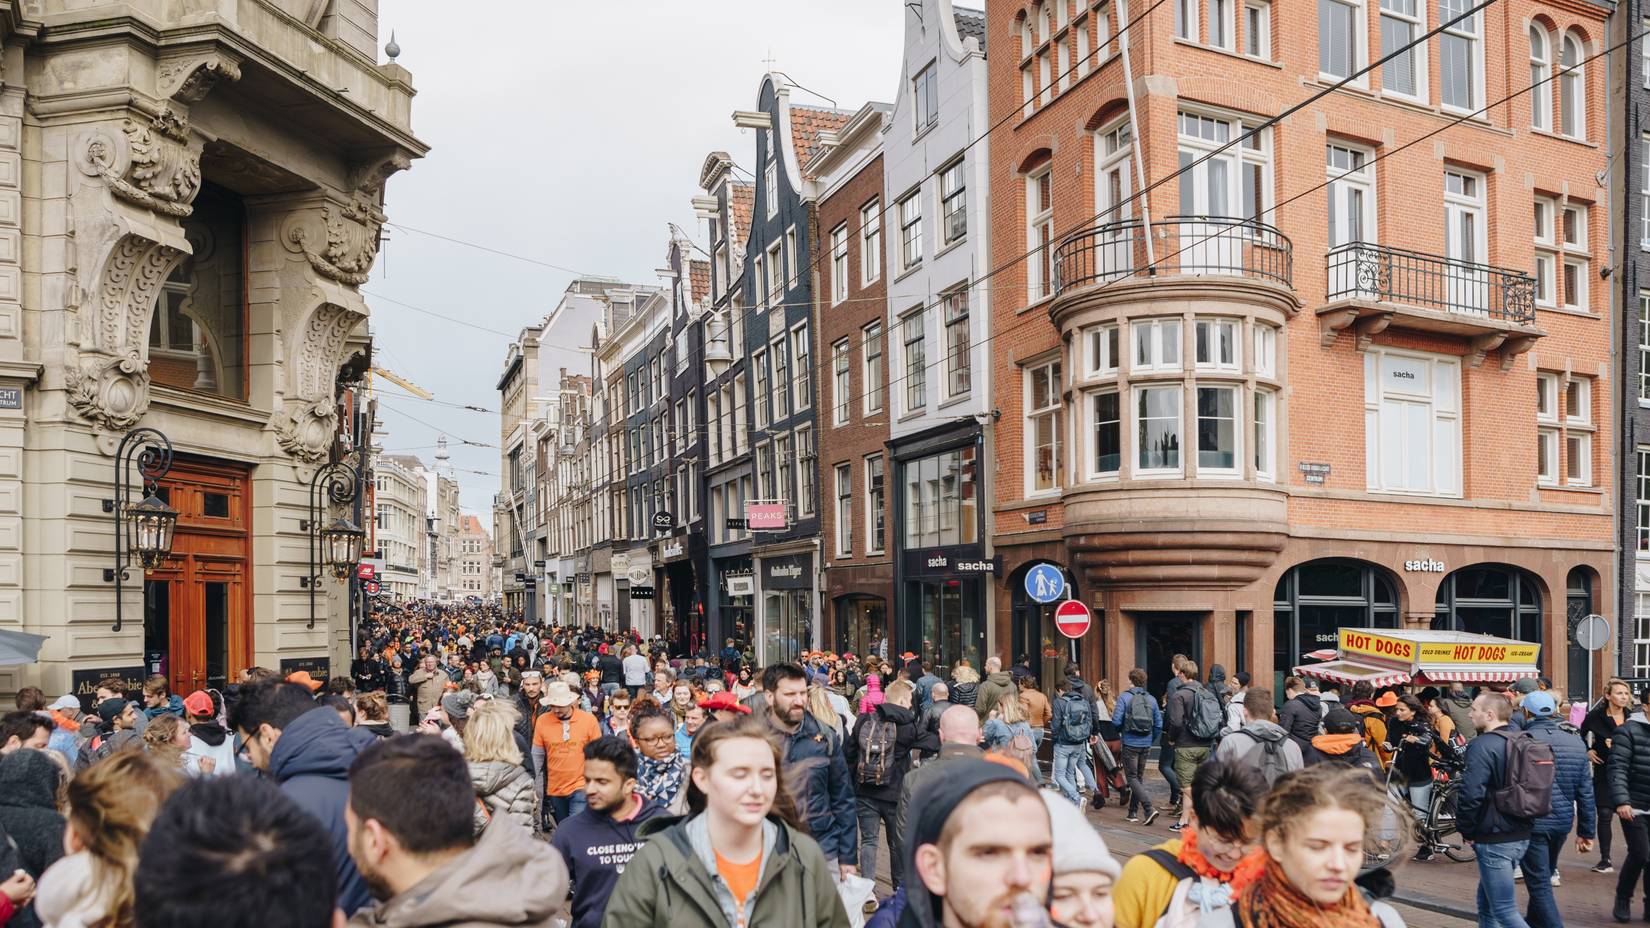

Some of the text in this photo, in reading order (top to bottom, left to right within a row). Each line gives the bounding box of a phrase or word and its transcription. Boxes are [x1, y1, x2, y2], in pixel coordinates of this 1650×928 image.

[1393, 371, 1415, 380] sacha
[927, 555, 947, 567] sacha
[958, 561, 994, 571] sacha
[1404, 558, 1445, 572] sacha
[1315, 632, 1339, 642] sach
[1346, 634, 1411, 658] HOT DOGS
[1453, 645, 1477, 661] HOT
[1478, 646, 1507, 661] DOGS
[586, 845, 615, 856] CLOSE
[599, 855, 612, 865] TO
